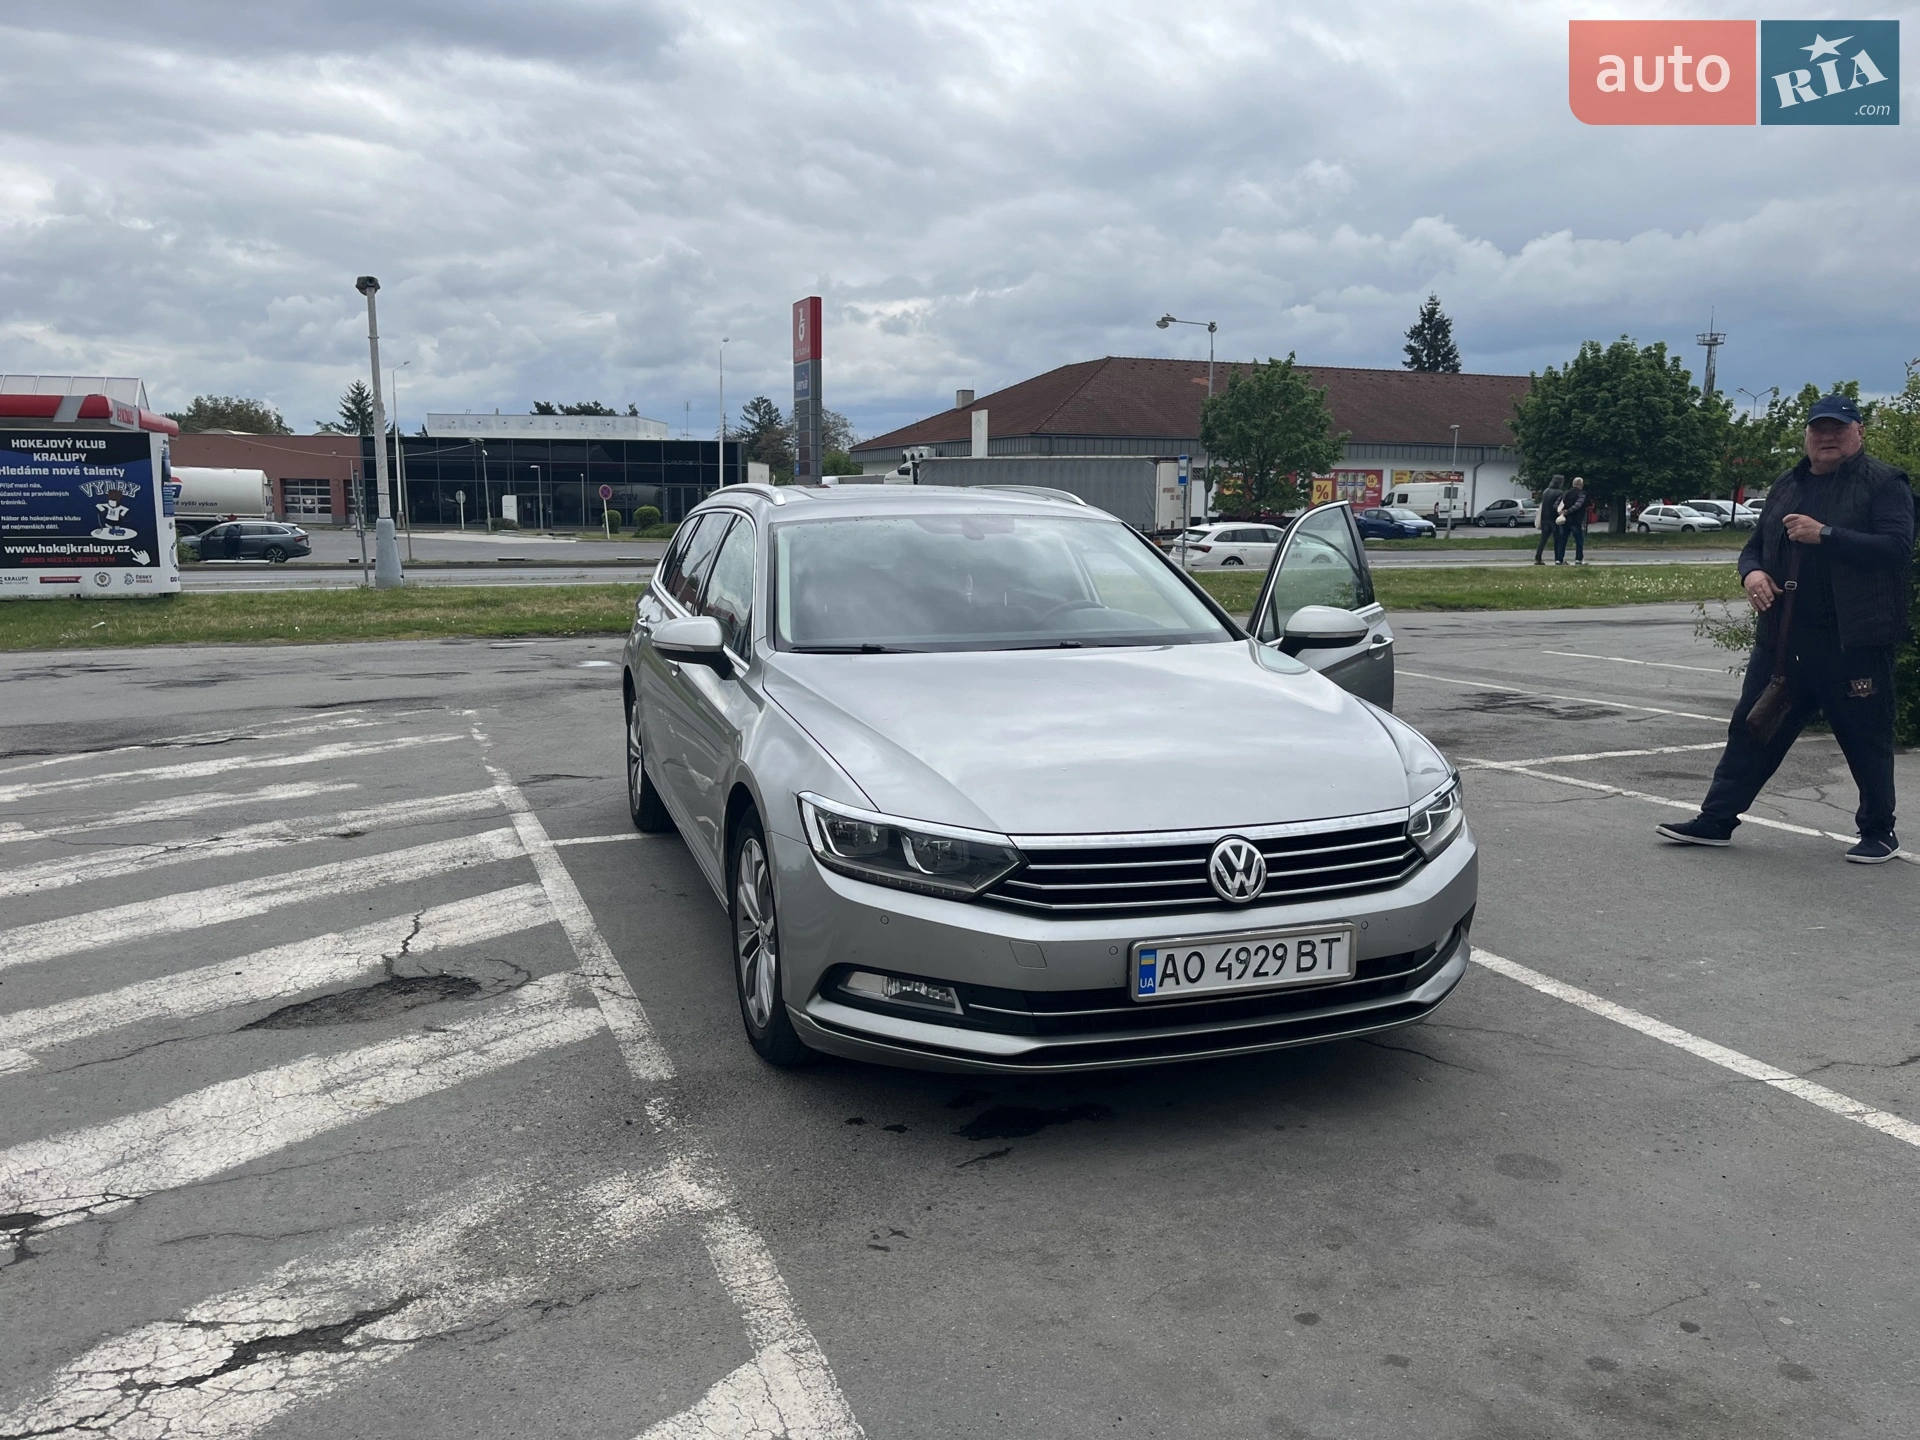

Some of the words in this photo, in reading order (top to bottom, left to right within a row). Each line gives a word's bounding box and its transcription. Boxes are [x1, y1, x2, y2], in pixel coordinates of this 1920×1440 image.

[11, 437, 73, 448] HOKEJOVÝ
[76, 440, 106, 449] KLUB
[33, 452, 87, 462] KRALUPY
[0, 465, 49, 476] Hledáme
[52, 466, 80, 475] nové
[83, 467, 125, 478] talenty
[4, 543, 131, 556] www.hokejkralupy.cz
[1158, 951, 1206, 988] AO
[1215, 943, 1288, 981] 4929
[1296, 937, 1342, 973] BT
[1139, 978, 1155, 989] UA
